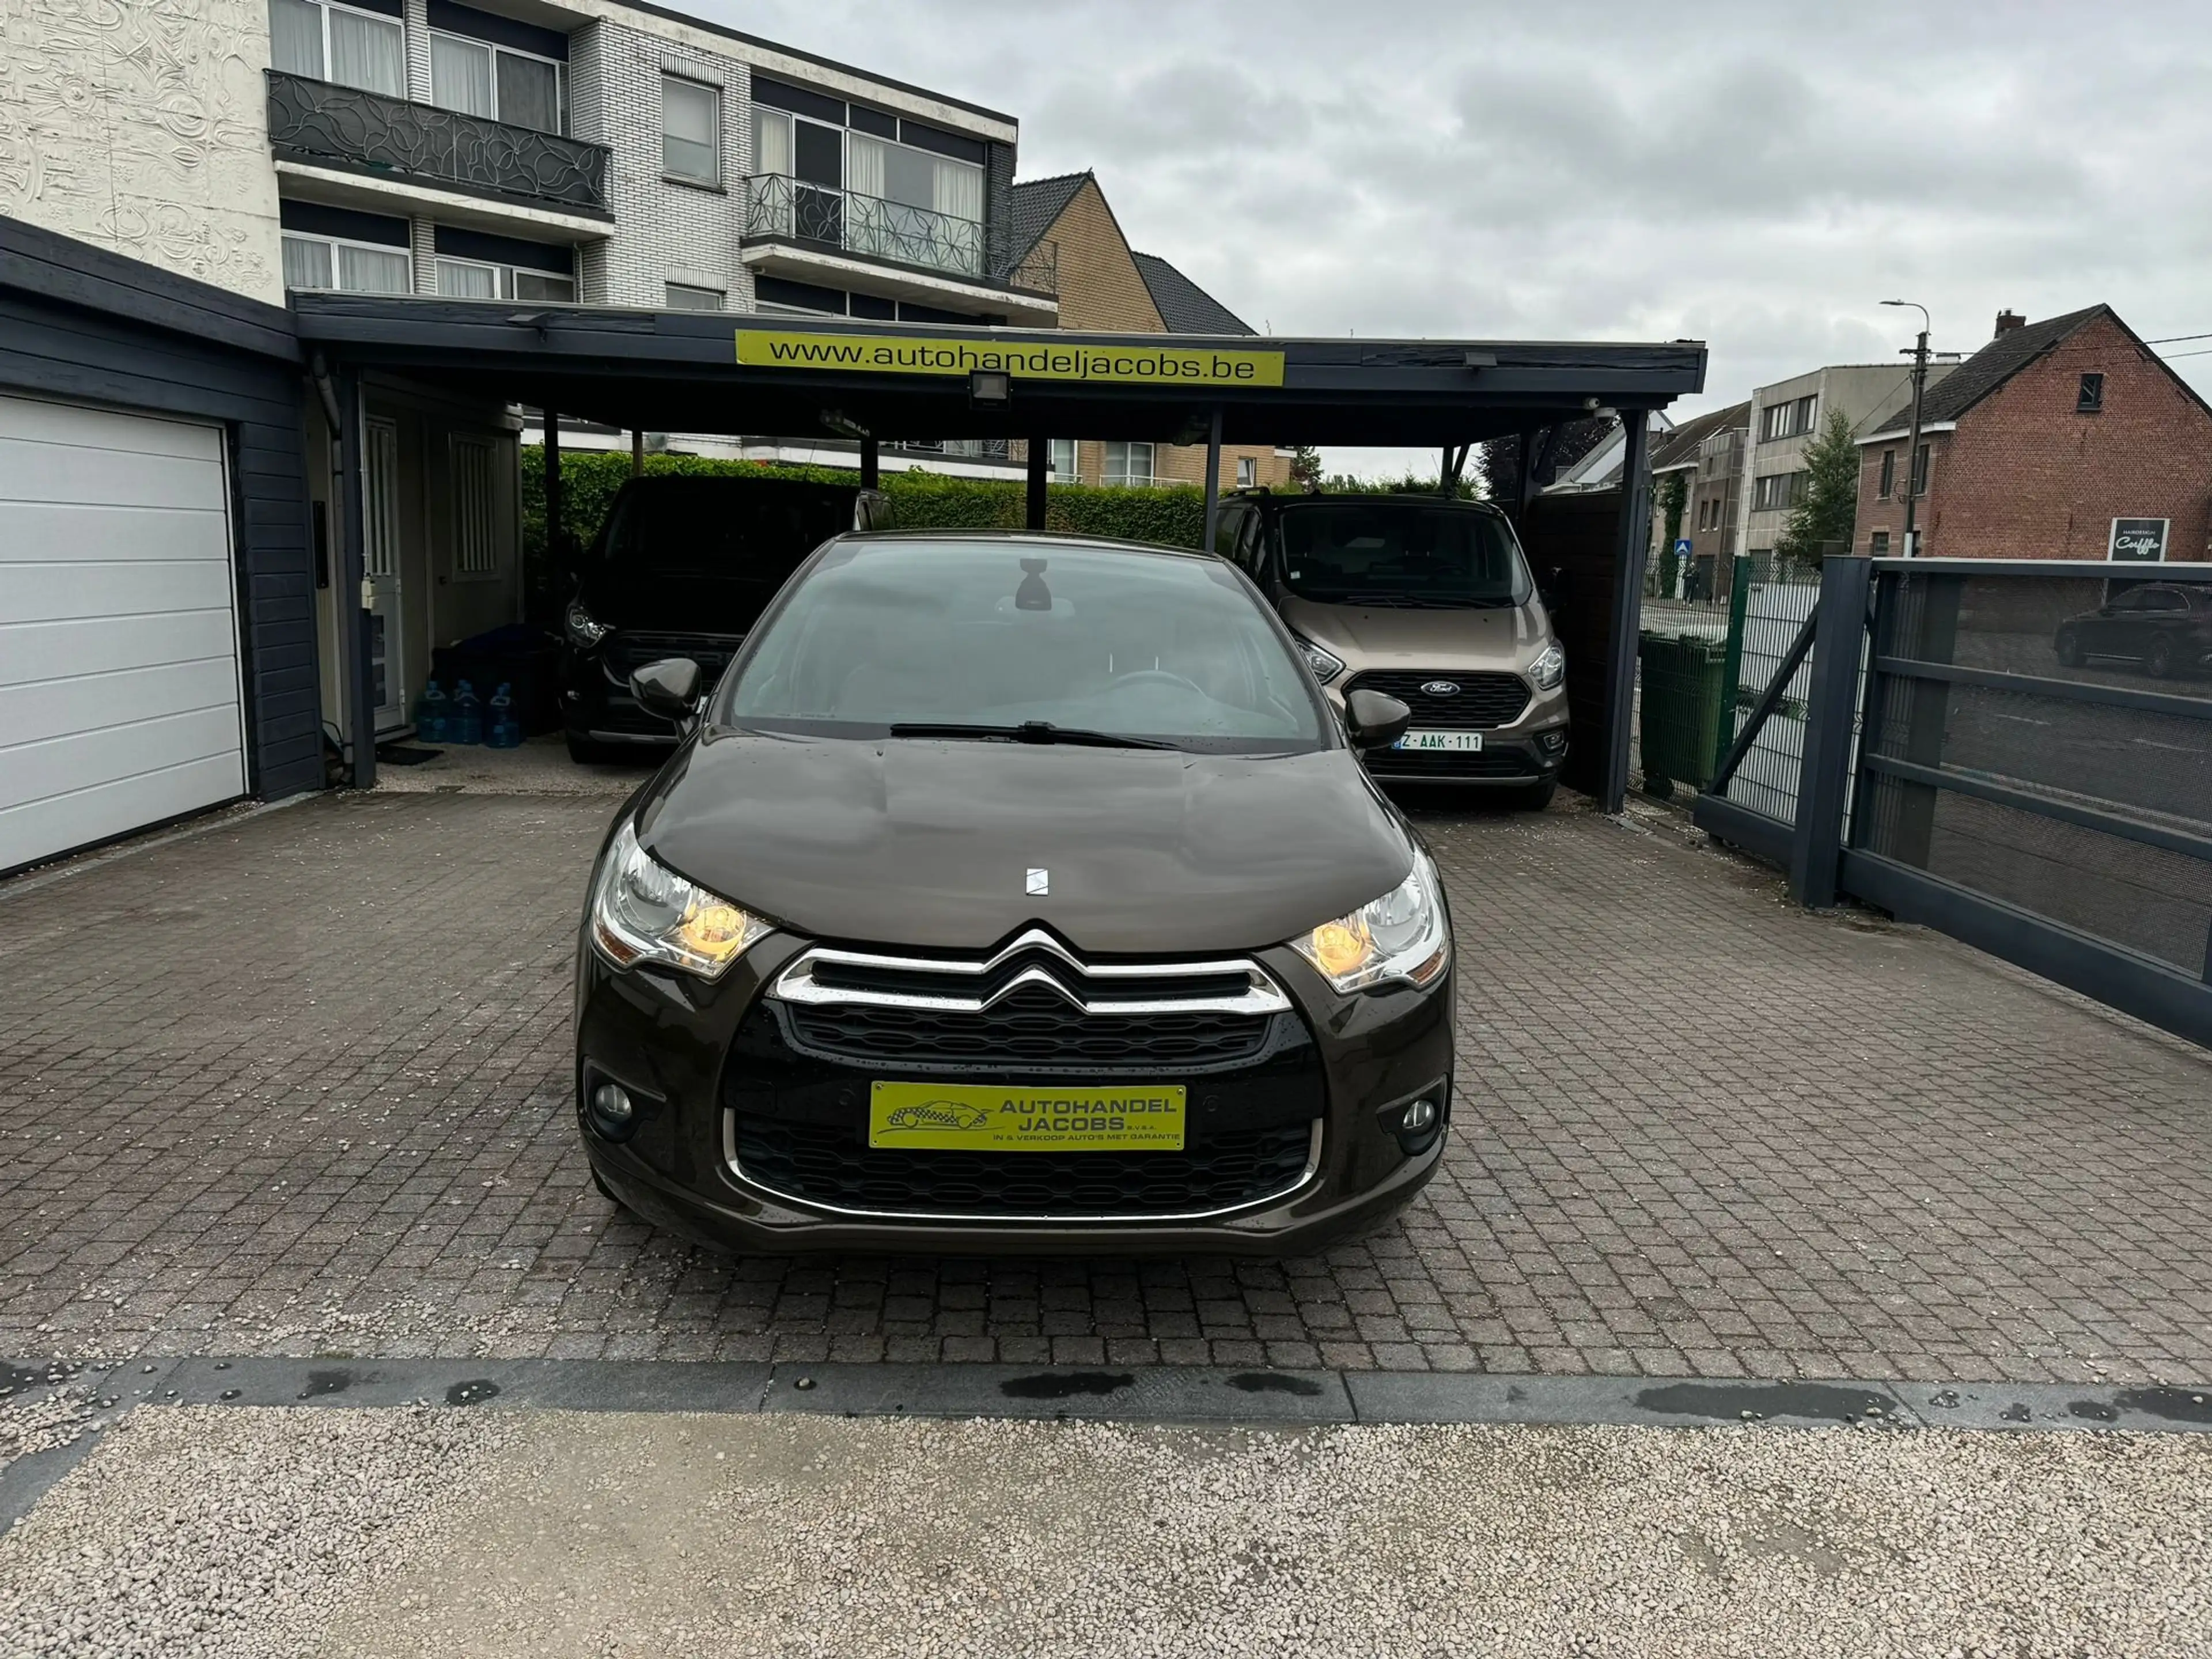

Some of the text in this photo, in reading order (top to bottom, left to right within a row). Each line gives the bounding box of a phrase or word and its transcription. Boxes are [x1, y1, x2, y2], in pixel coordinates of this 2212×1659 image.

[769, 342, 1255, 379] www.autohandeljacobs.be
[1430, 683, 1452, 692] Ford
[999, 1099, 1177, 1114] AUTOHANDEL
[1018, 1117, 1124, 1131] JACOBS
